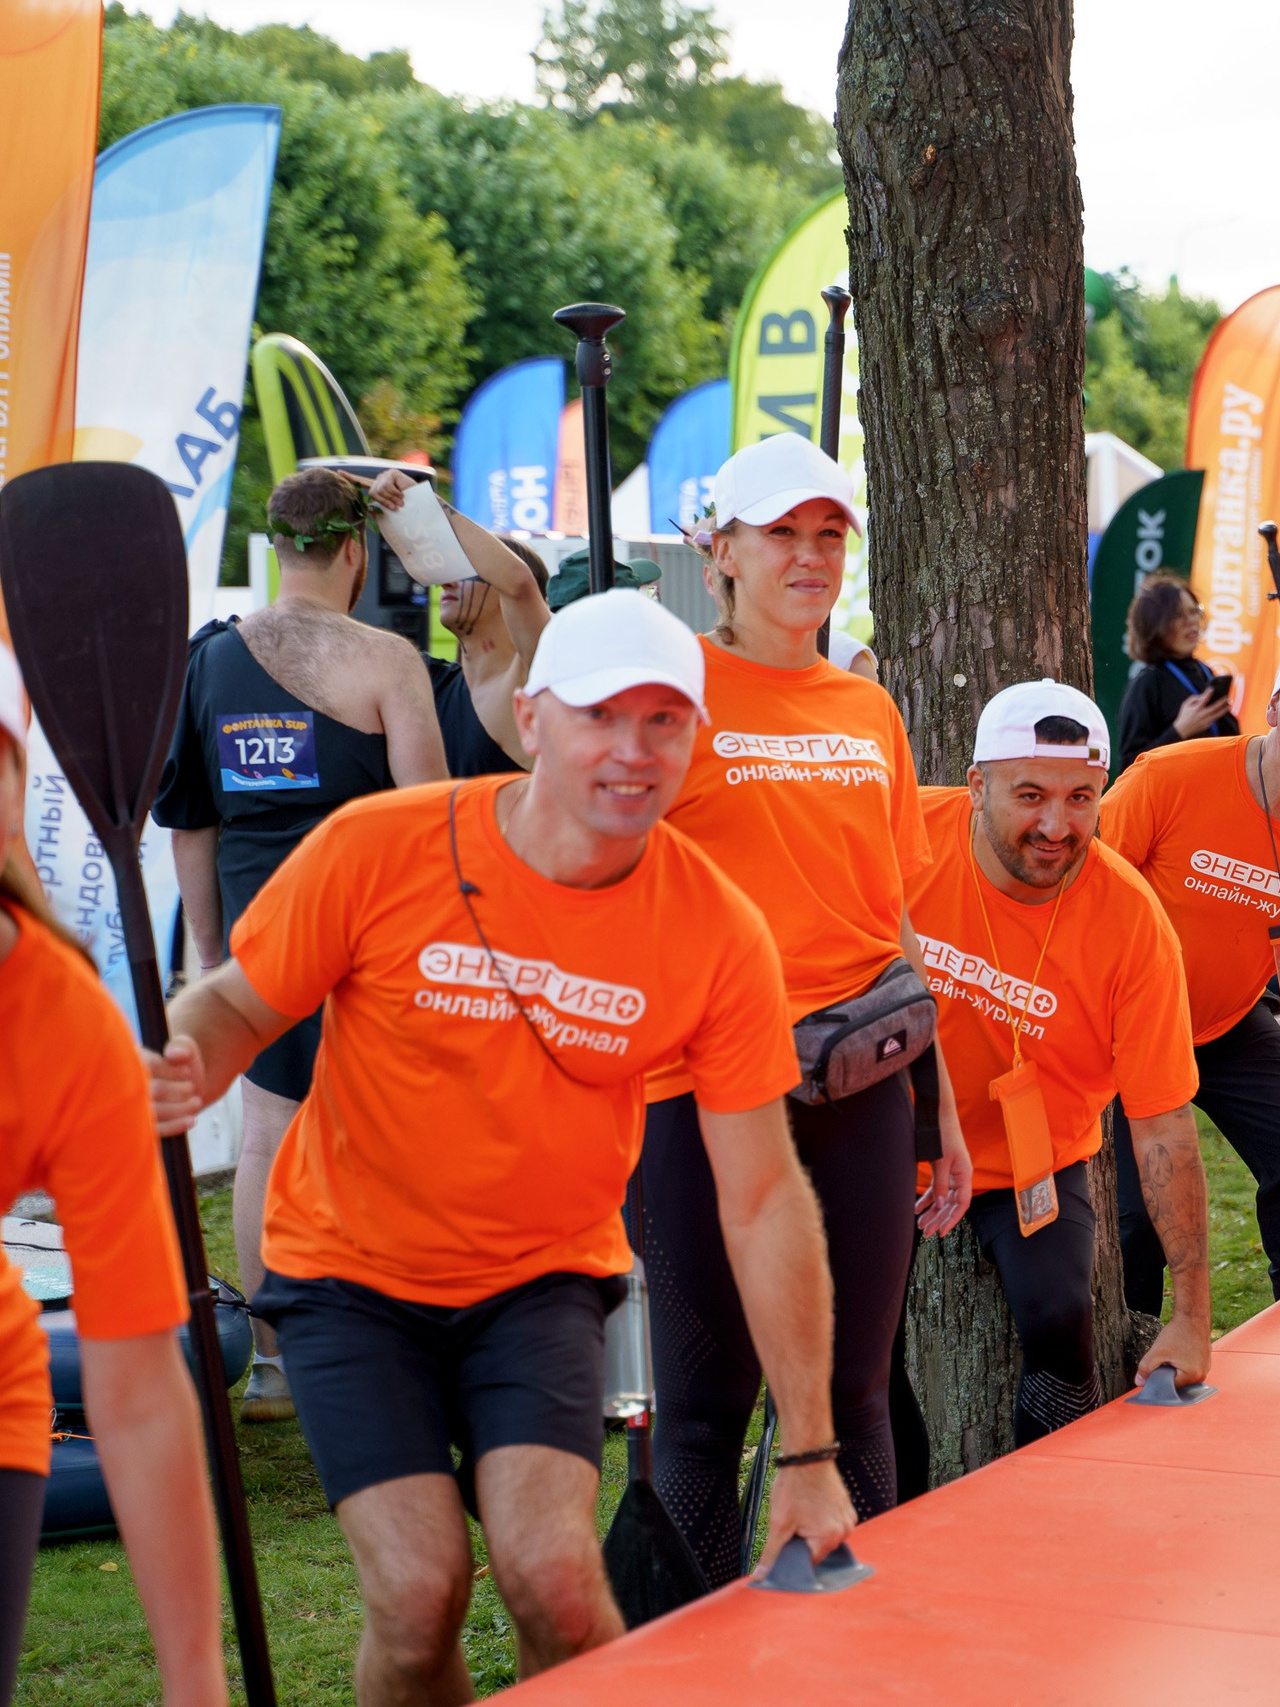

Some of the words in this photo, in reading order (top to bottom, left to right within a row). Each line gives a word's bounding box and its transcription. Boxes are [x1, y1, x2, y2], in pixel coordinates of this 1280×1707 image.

[1205, 382, 1264, 654] фонтанка.ру
[234, 736, 295, 765] 1213
[285, 720, 307, 731] SUP
[414, 990, 630, 1056] онлайн-журнал
[924, 977, 1045, 1040] айн-журнал
